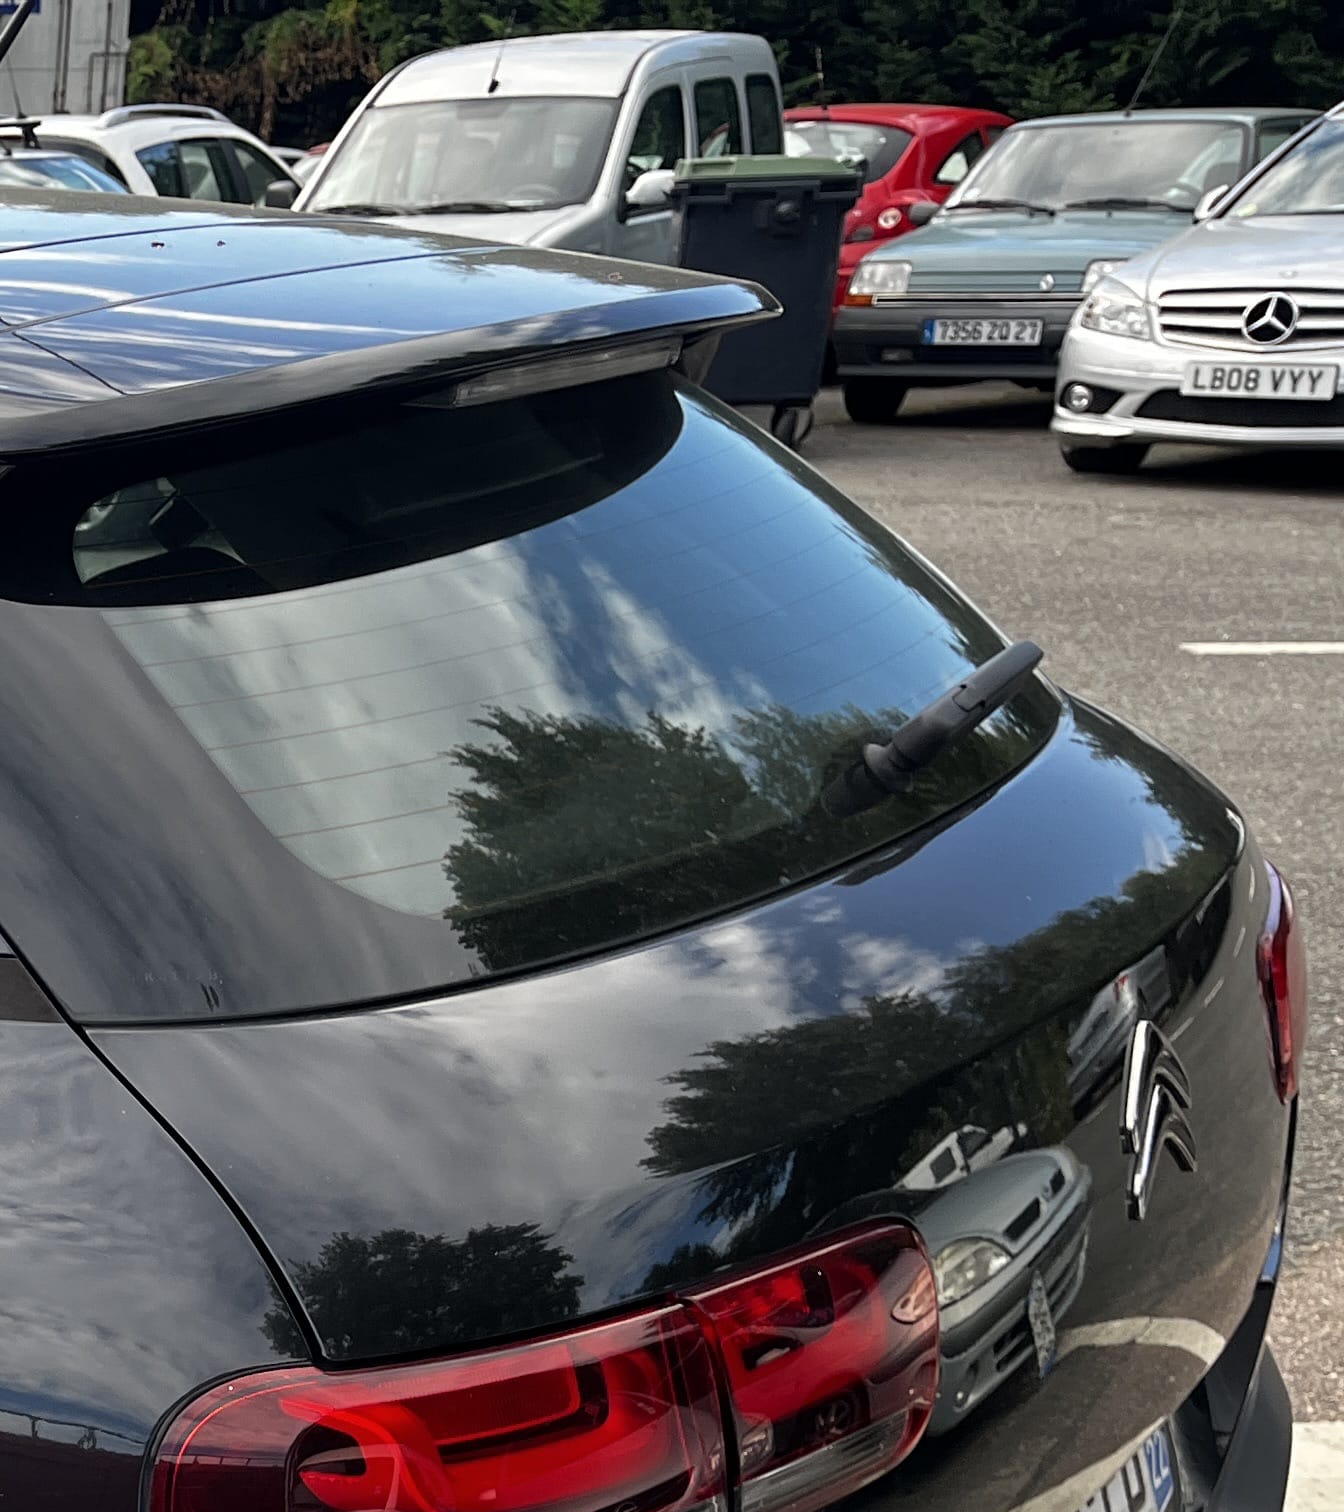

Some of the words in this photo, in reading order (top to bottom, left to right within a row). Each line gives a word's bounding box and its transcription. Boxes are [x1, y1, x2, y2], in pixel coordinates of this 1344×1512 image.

[939, 320, 983, 341] 7356
[1014, 320, 1039, 341] 27
[1193, 367, 1260, 391] LB08
[1271, 369, 1323, 394] VYY
